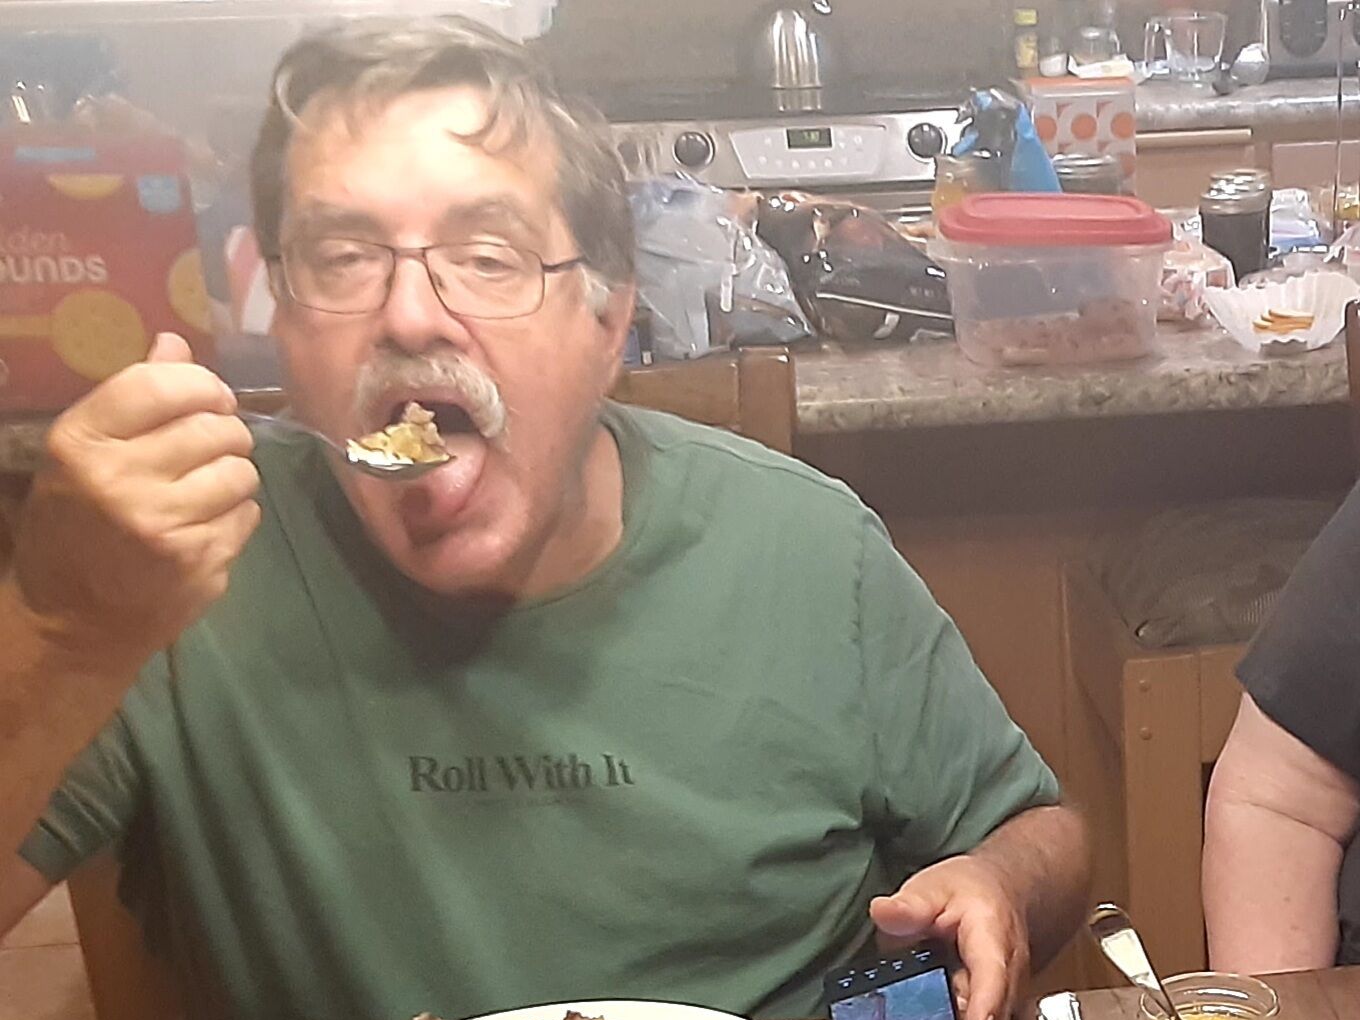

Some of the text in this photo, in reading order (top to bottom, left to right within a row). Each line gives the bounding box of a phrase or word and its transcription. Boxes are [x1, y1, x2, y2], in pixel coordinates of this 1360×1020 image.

[409, 752, 635, 792] Roll With It
